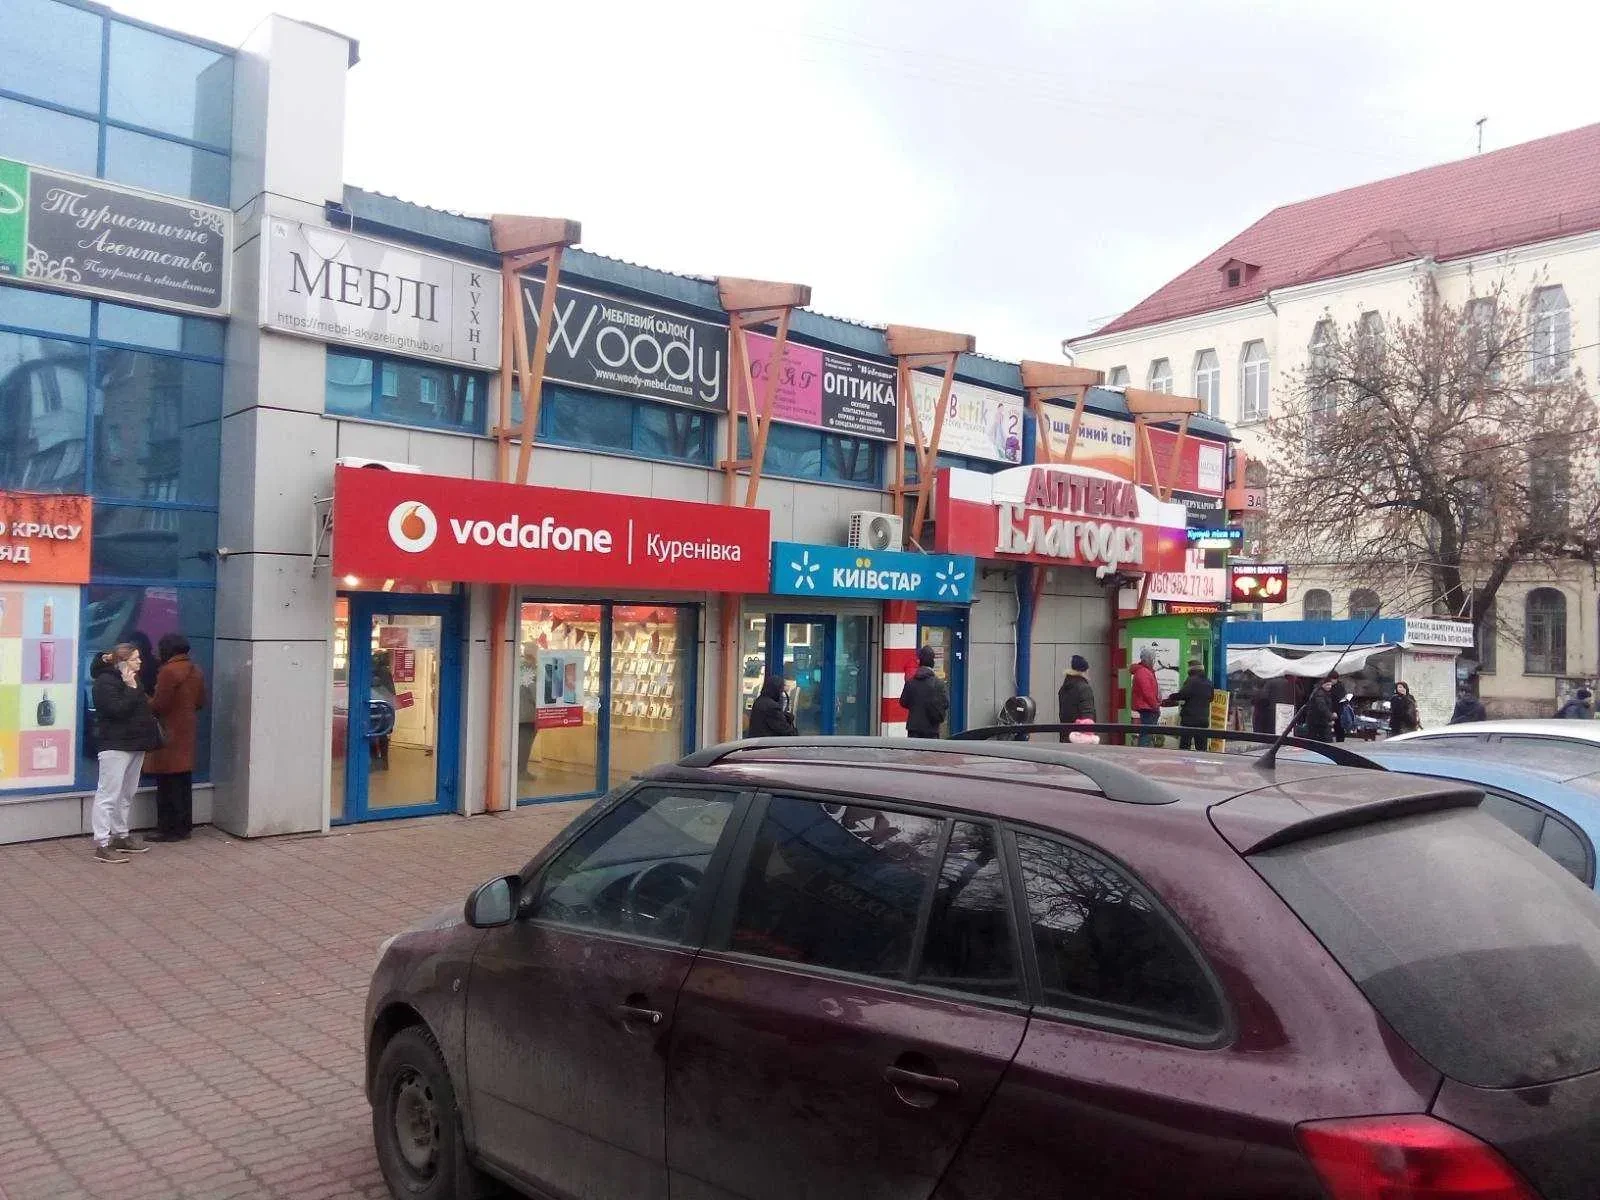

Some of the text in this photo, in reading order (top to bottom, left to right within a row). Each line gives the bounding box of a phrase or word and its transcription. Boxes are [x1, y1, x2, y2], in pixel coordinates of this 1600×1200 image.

[41, 188, 208, 244] Туристичне
[78, 229, 214, 273] Агентство
[288, 251, 440, 323] МЕБЛІ
[469, 272, 481, 361] КУХНІ
[602, 306, 688, 340] МЕБЛЕВИЙ САЛОН
[524, 287, 720, 402] Woody
[596, 368, 693, 397] www.woody-mebel.com.ua
[823, 372, 896, 407] ОПТИКА
[1009, 415, 1018, 435] 2
[1053, 420, 1108, 442] швйний
[1024, 467, 1140, 519] АПТЕКА
[12, 521, 82, 540] КРАСУ
[450, 515, 612, 553] vodafone
[647, 533, 741, 562] Куренівка
[833, 557, 921, 591] КИЇВСТАР
